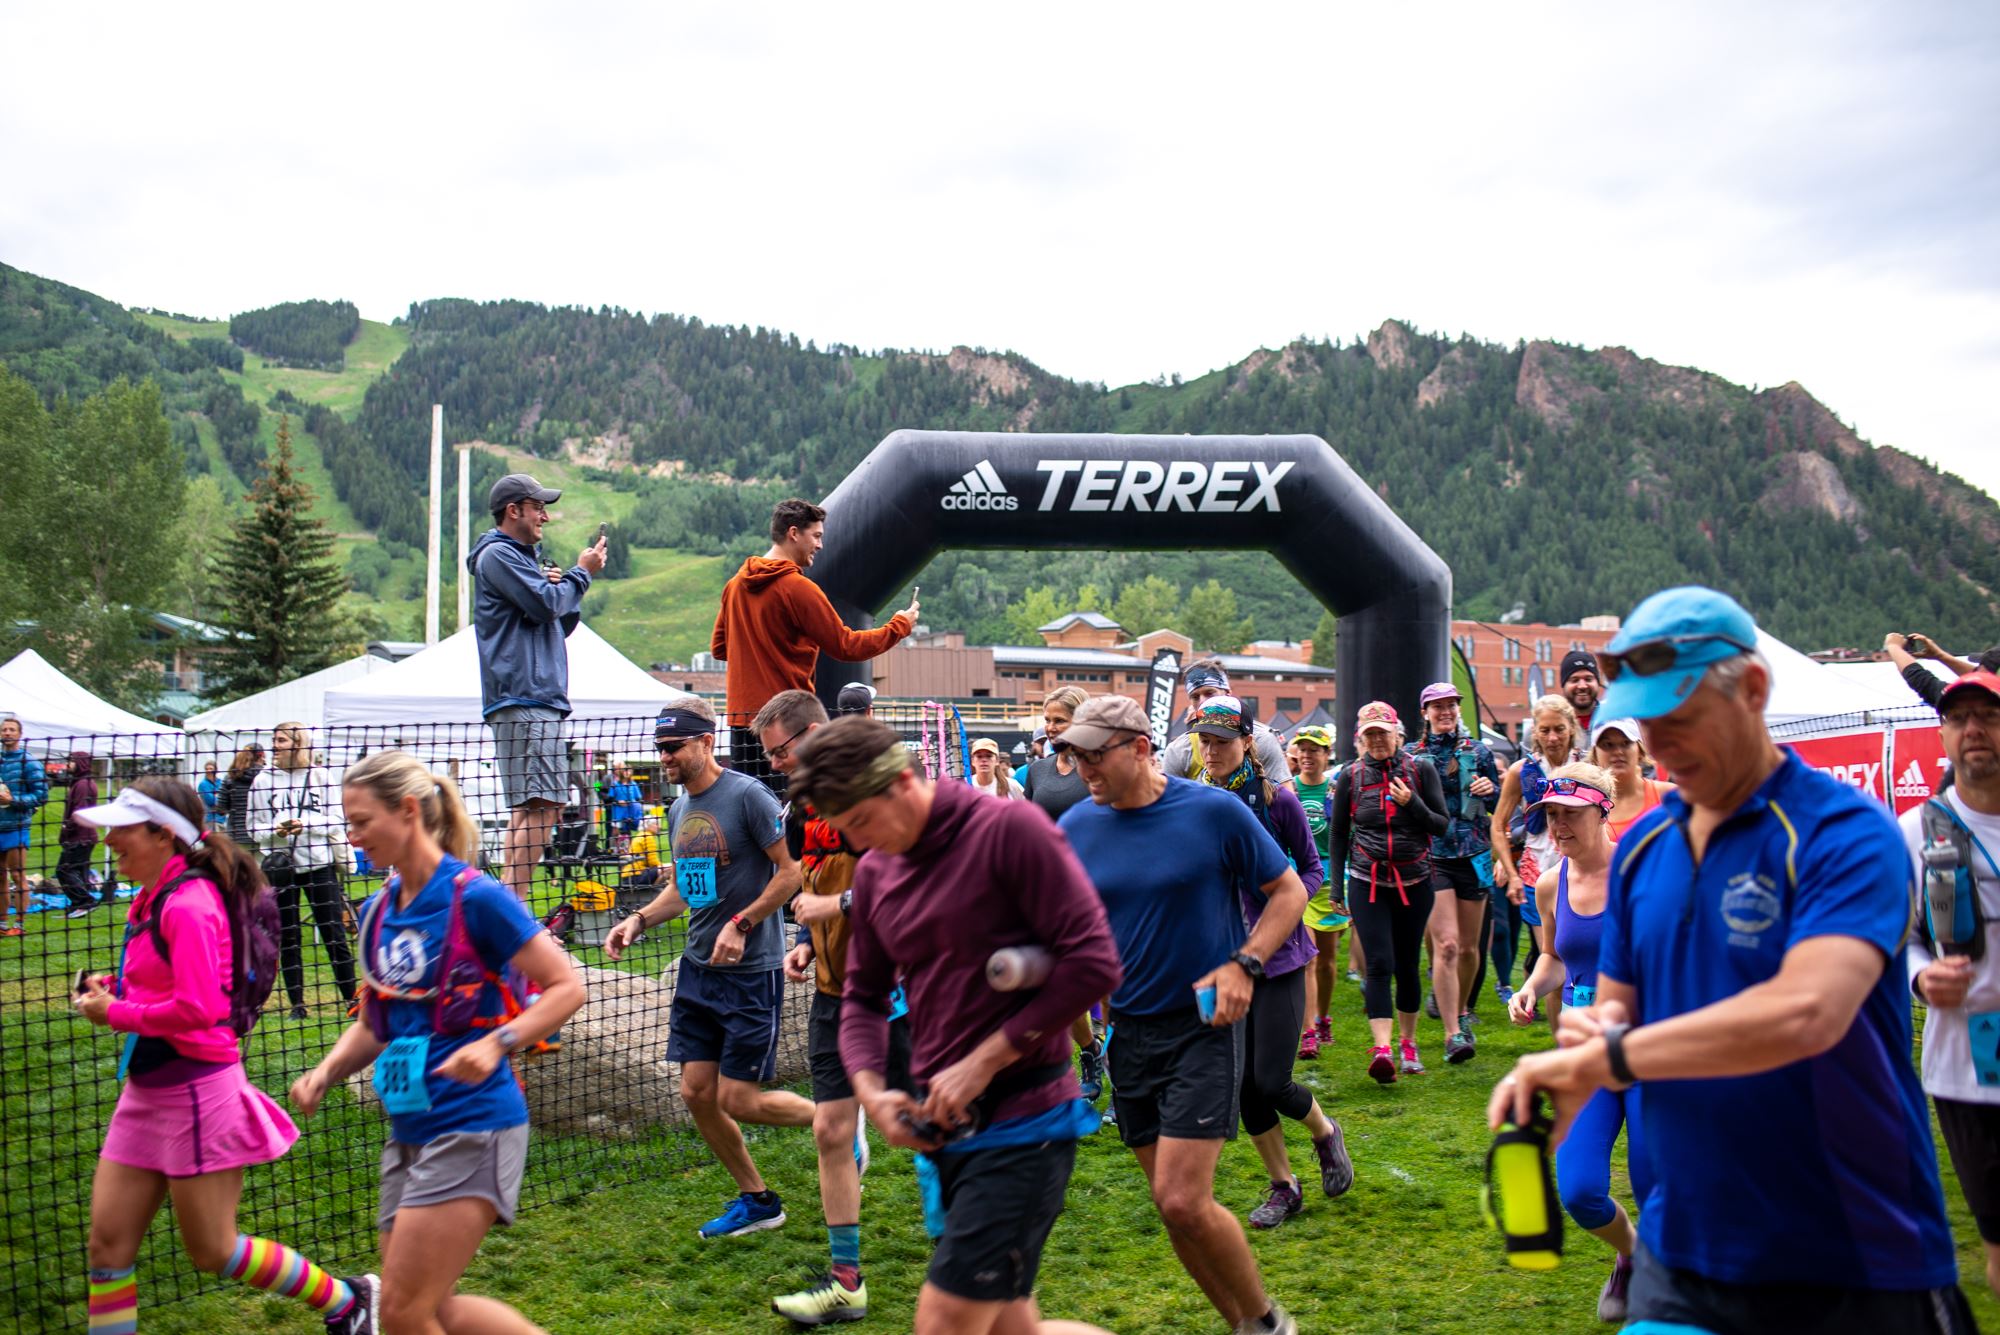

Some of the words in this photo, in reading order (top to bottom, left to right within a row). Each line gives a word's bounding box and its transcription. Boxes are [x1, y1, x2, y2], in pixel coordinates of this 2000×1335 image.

[941, 490, 1018, 511] adidas
[1036, 460, 1296, 512] TERREX
[1811, 762, 1881, 800] REX
[1895, 785, 1930, 797] adidas
[688, 862, 711, 871] TERREX
[686, 873, 708, 896] 331
